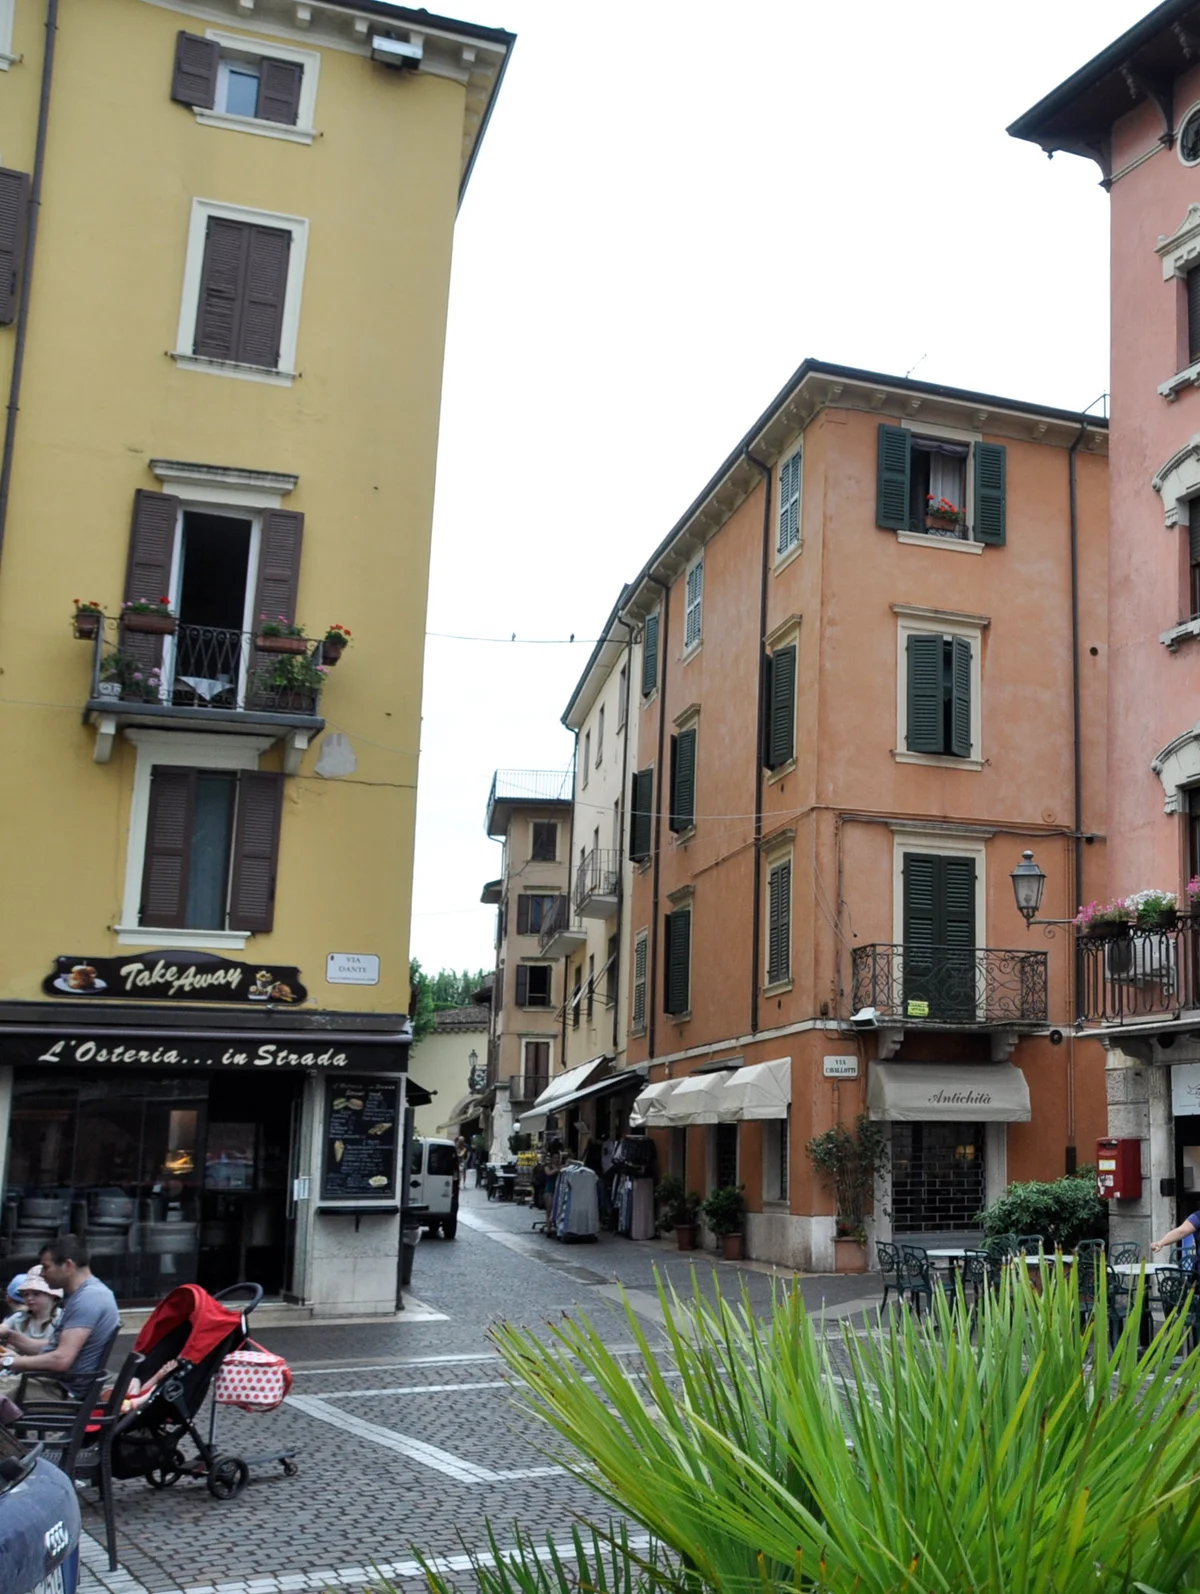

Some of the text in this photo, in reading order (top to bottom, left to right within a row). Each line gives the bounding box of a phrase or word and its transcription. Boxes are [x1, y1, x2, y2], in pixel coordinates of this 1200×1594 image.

[120, 960, 242, 995] Take Away
[222, 1046, 248, 1066] in
[253, 1045, 348, 1067] Strada
[928, 1089, 992, 1104] Antichità
